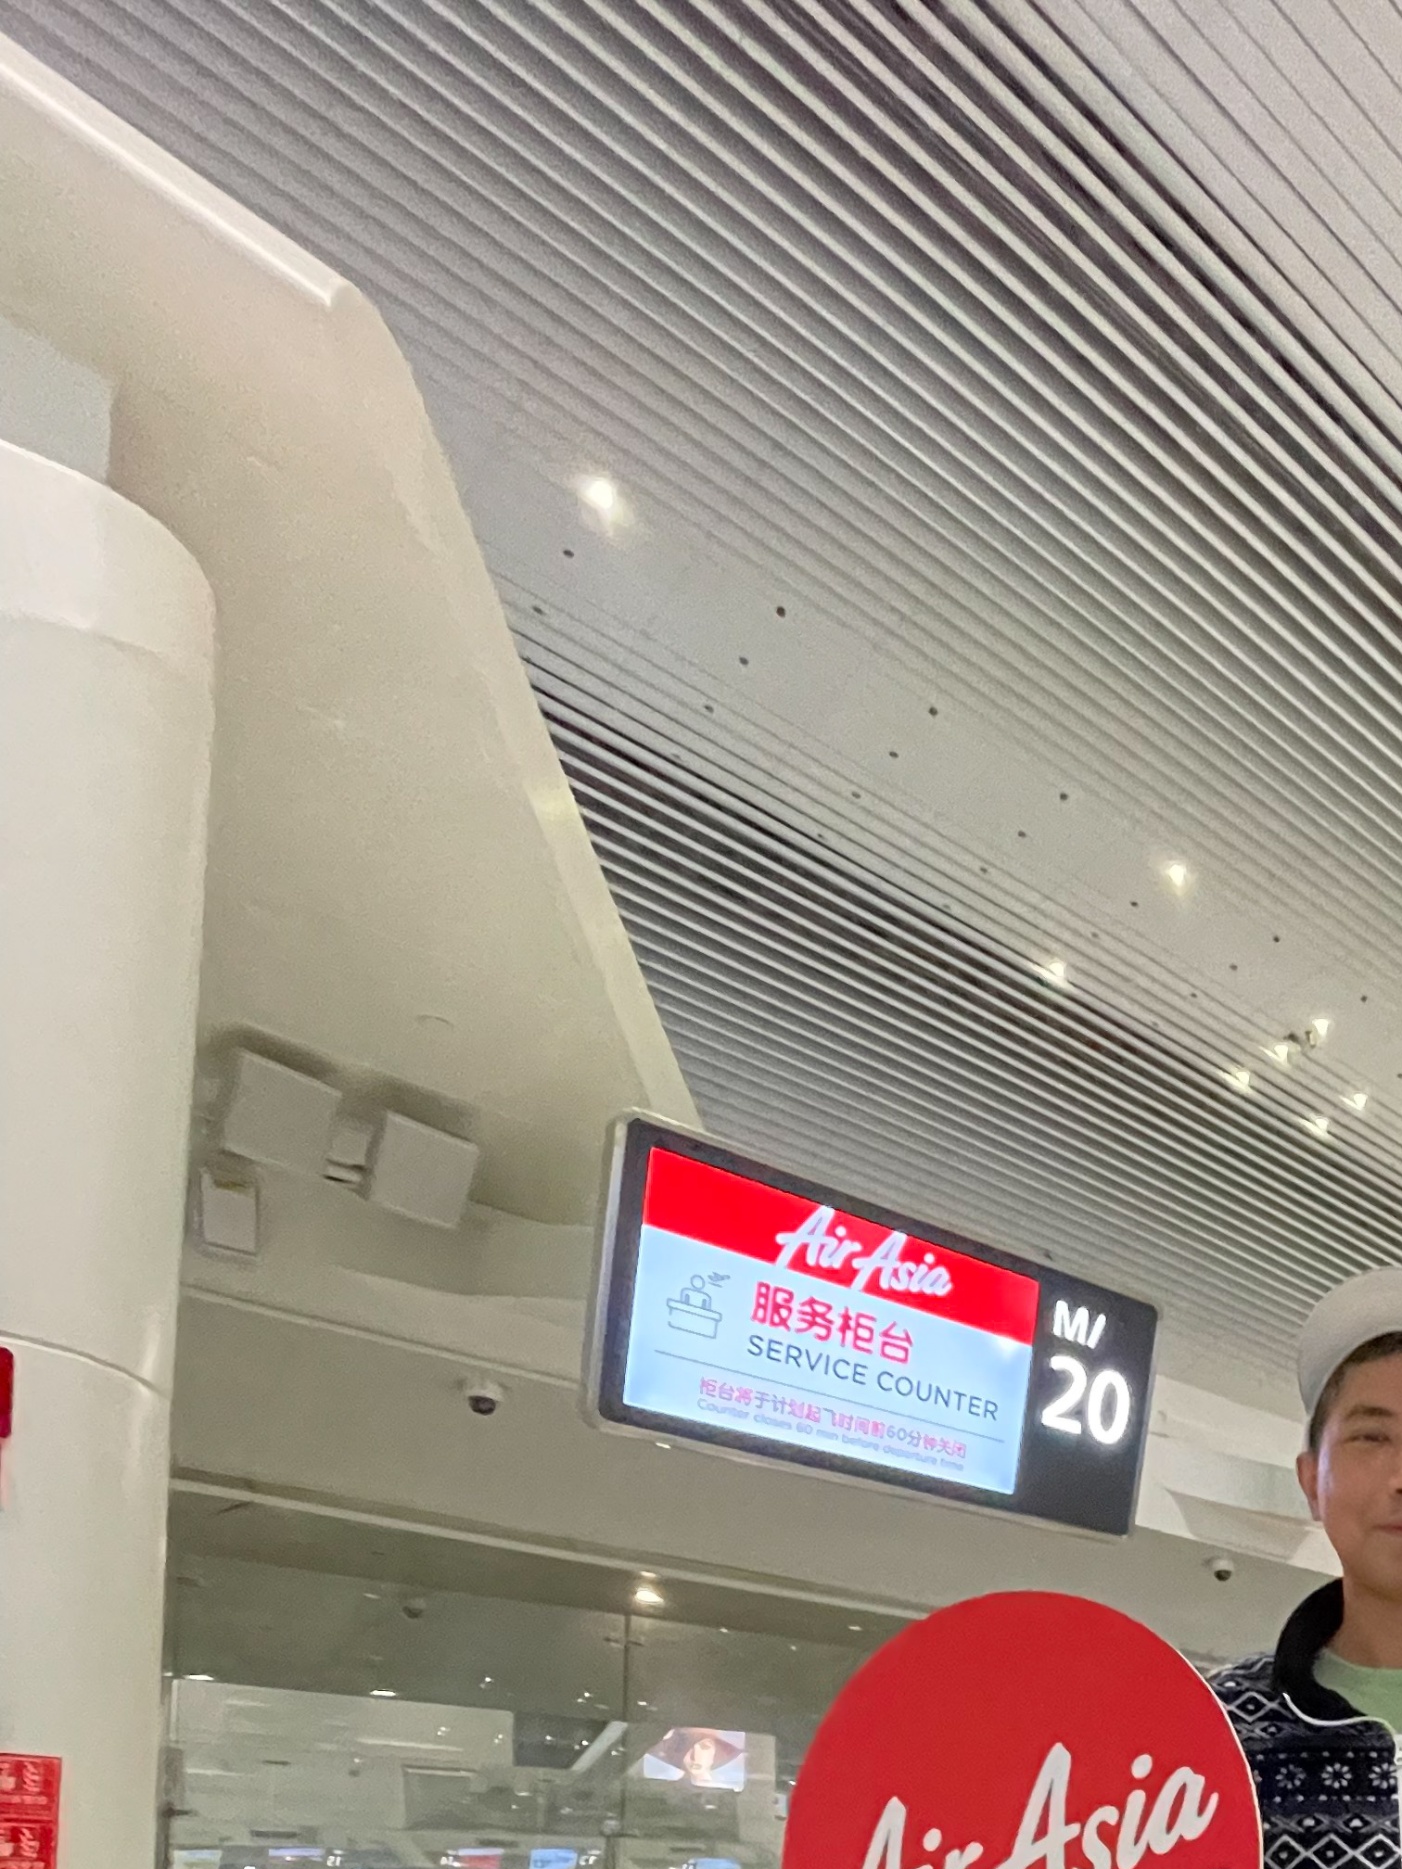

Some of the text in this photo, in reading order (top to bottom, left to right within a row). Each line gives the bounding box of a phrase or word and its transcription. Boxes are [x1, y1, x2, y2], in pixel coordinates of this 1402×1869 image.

[750, 1280, 914, 1366] 服务柜台
[1052, 1299, 1107, 1350] MI
[747, 1334, 999, 1421] SERVICE COUNTER
[1041, 1354, 1131, 1445] 20
